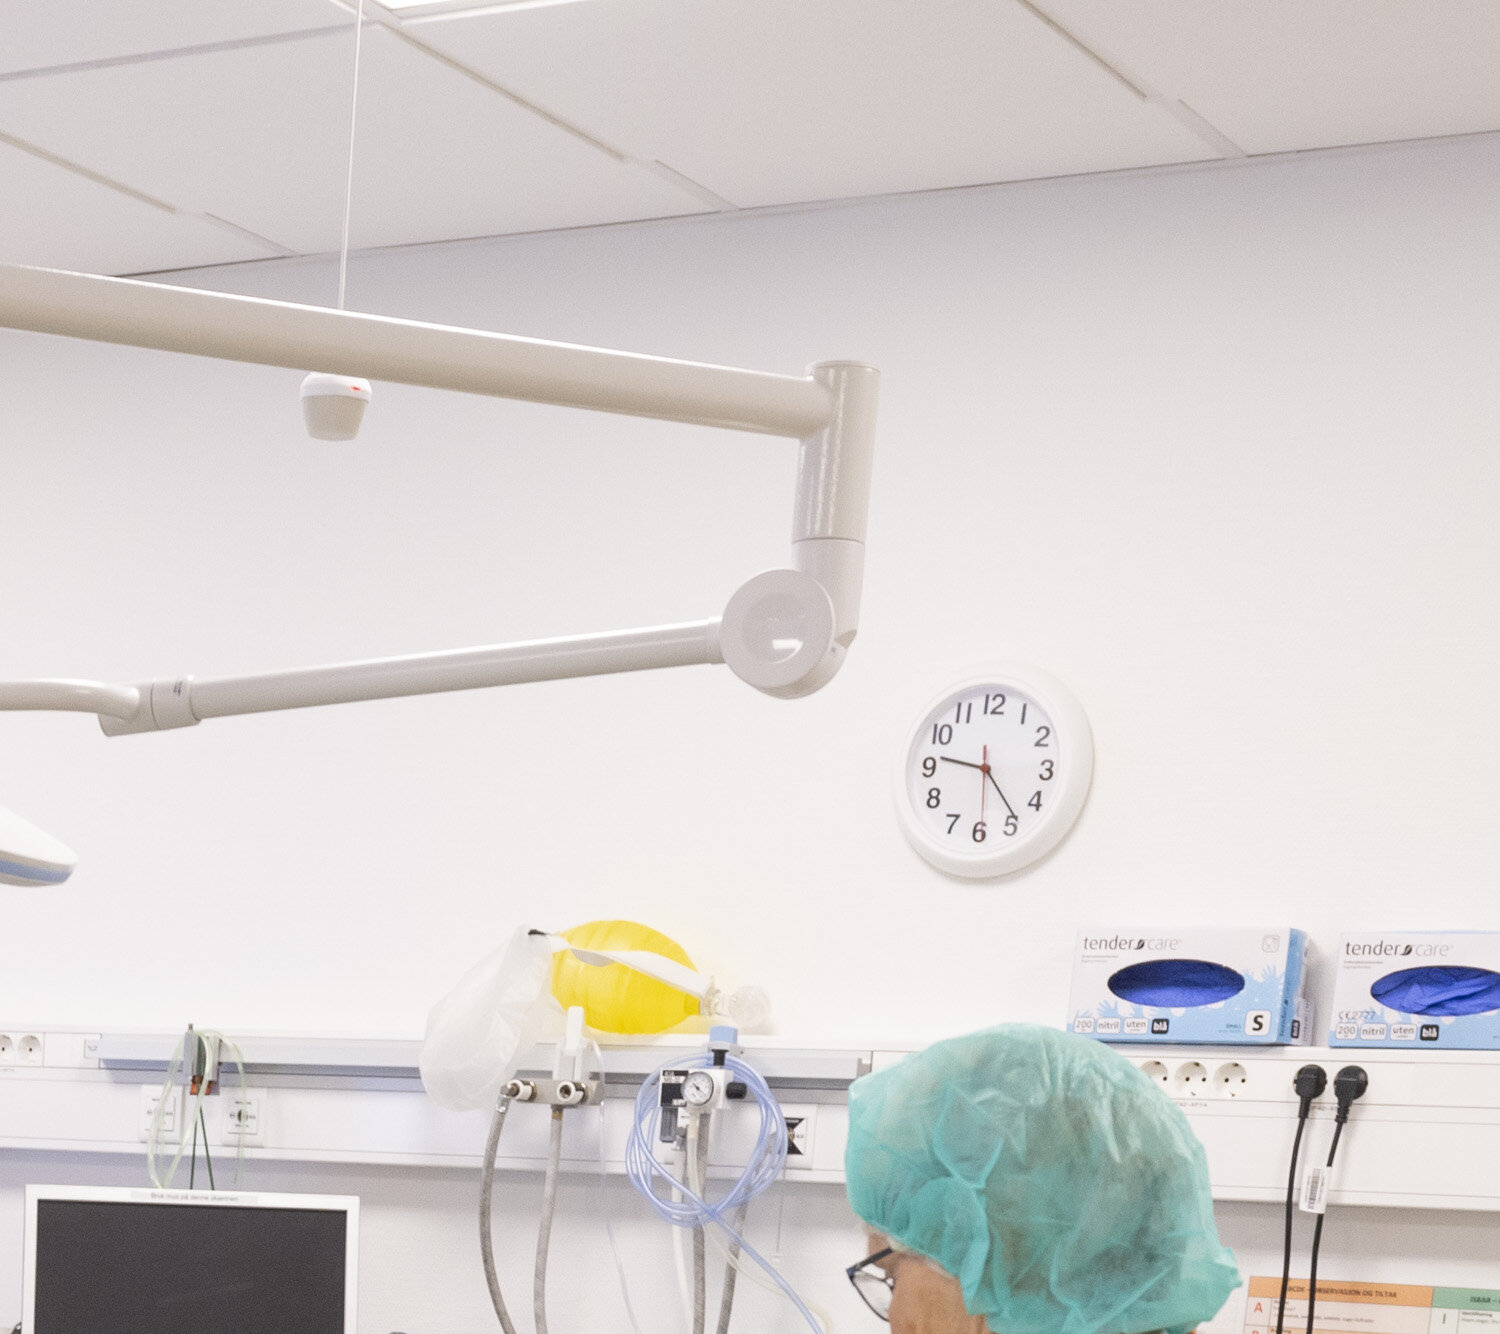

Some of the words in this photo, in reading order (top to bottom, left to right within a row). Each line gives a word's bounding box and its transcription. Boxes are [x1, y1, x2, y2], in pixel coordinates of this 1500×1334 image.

[955, 702, 972, 724] 11
[983, 693, 1006, 715] 12
[1020, 703, 1027, 724] 1
[932, 723, 953, 745] 10
[1034, 726, 1051, 747] 2
[921, 756, 936, 778] 9
[1038, 759, 1055, 781] 3
[926, 787, 941, 809] 8
[1027, 790, 1042, 812] 4
[946, 813, 961, 834] 7
[972, 821, 987, 843] 6
[1003, 815, 1018, 836] 5
[1083, 935, 1133, 951] tender
[1148, 937, 1179, 951] care
[1345, 940, 1399, 957] tender
[1416, 942, 1449, 957] care
[1076, 1020, 1093, 1029] 200
[1097, 1019, 1120, 1030] nitril
[1126, 1020, 1147, 1029] uten
[1252, 1014, 1264, 1032] S
[1338, 1026, 1356, 1036] 200
[1362, 1026, 1386, 1037] nitril
[1392, 1026, 1415, 1036] uten
[1313, 1287, 1361, 1297] BSERVASJON
[1362, 1290, 1373, 1298] OG
[1253, 1302, 1263, 1313] A
